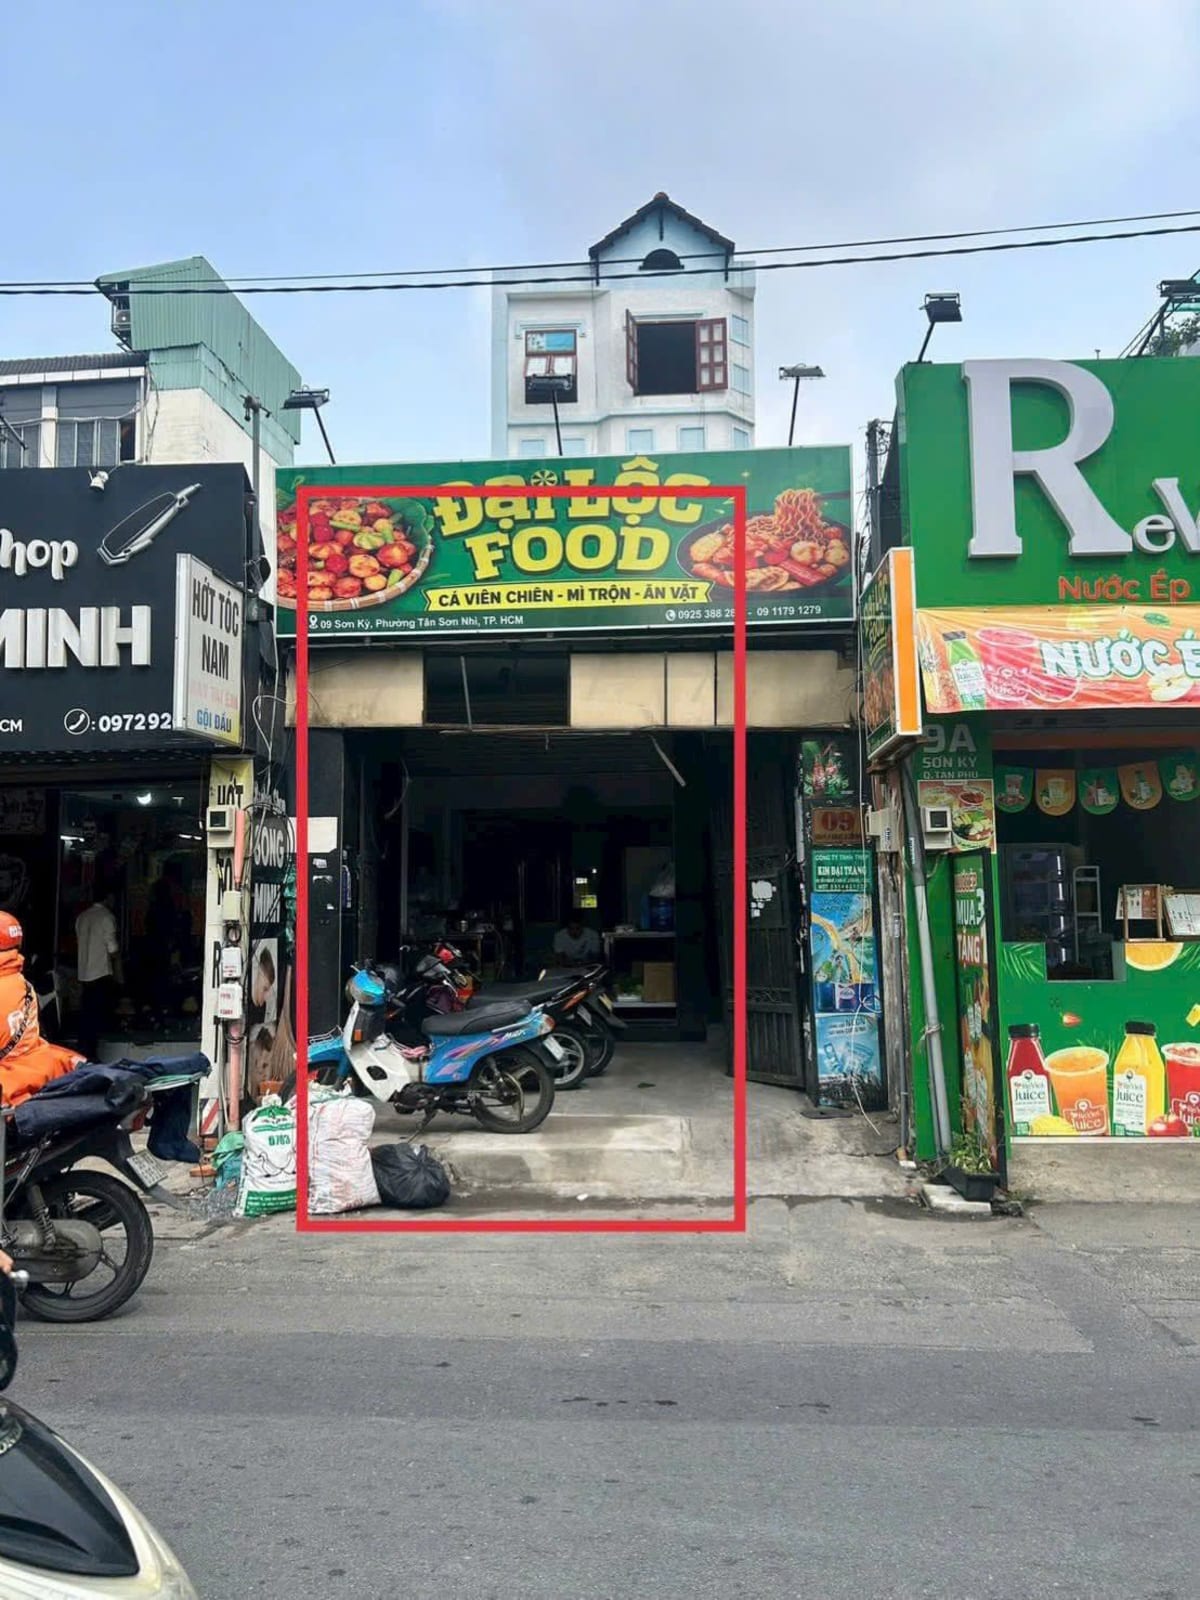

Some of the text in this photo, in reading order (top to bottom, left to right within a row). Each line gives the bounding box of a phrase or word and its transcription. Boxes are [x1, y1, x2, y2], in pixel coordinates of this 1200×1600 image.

[465, 524, 671, 580] FOOD
[438, 590, 462, 607] CÁ
[465, 588, 501, 605] VIÊN
[506, 586, 554, 603] CHIÊN
[567, 584, 584, 602] MÌ
[589, 584, 630, 604] TRỘN
[1058, 568, 1191, 604] Nước Ép
[192, 576, 239, 638] HỚT TÓC
[320, 621, 332, 629] 09
[334, 619, 355, 629] Sơn
[375, 618, 416, 630] Phường
[419, 617, 436, 627] Tân
[438, 617, 459, 627] Sơn
[483, 616, 498, 625] TP.
[501, 615, 524, 625] HCM
[678, 610, 701, 620] 0925
[704, 609, 721, 619] 388
[757, 607, 769, 617] 09
[772, 606, 795, 616] 1179
[798, 605, 821, 615] 1279
[201, 634, 230, 680] NAM
[1040, 628, 1169, 679] NƯỚC
[922, 723, 977, 753] 9A
[821, 811, 855, 832] 09
[956, 887, 985, 926] MUA 3
[957, 926, 980, 968] TẶNG
[1015, 1088, 1046, 1101] Juice
[1116, 1087, 1144, 1103] Juice
